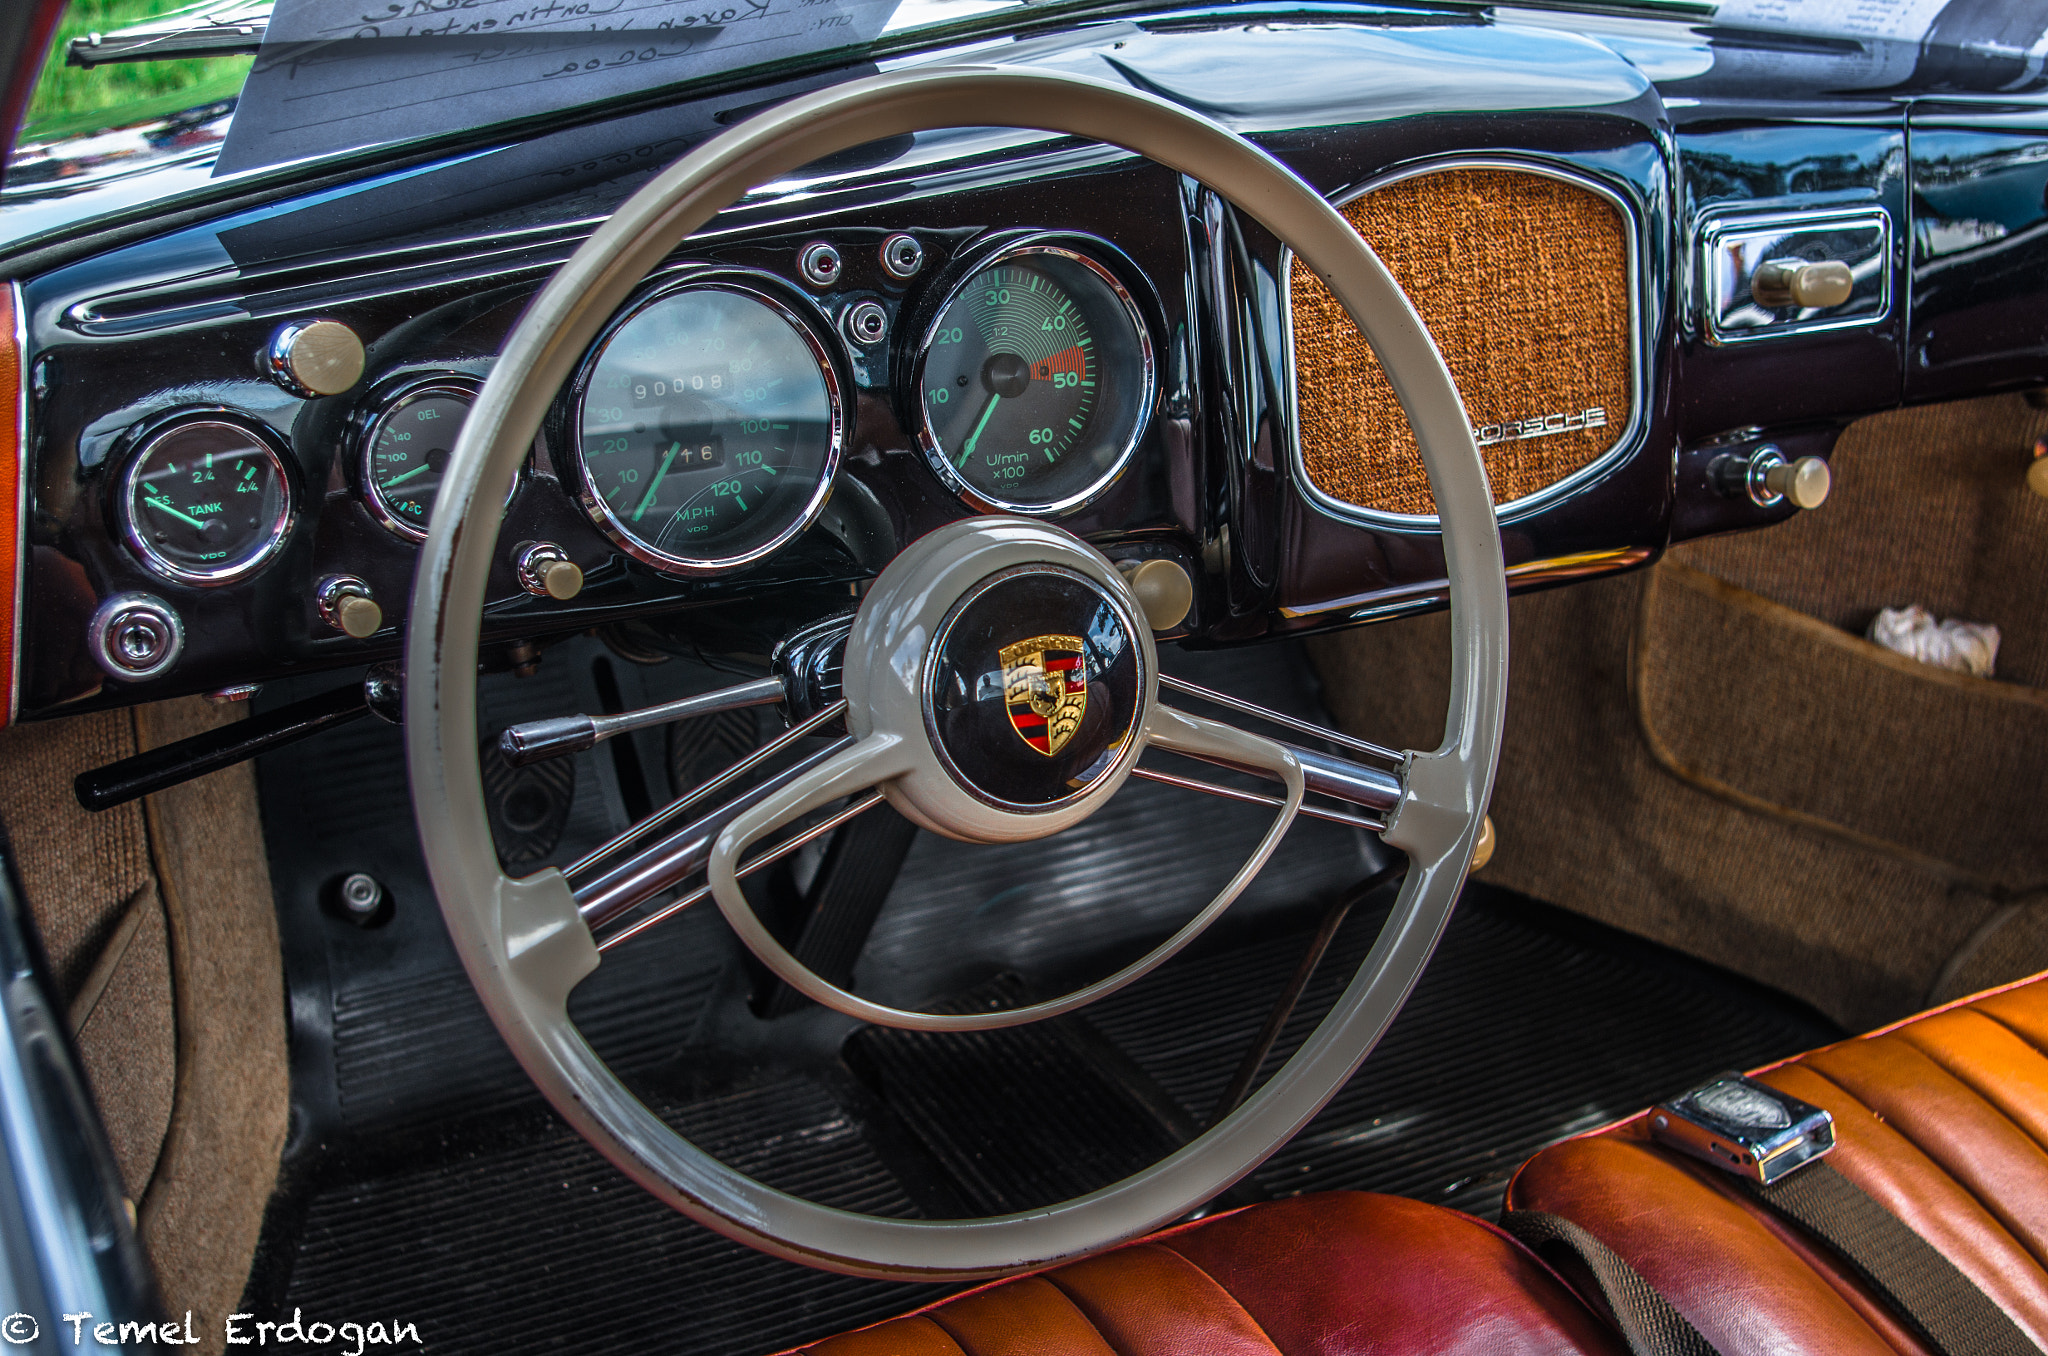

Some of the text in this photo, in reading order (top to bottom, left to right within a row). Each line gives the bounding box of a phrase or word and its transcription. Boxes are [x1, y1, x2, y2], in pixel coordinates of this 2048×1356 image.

[985, 289, 1010, 306] 30
[1041, 316, 1066, 331] 40
[937, 327, 963, 344] 20
[993, 327, 1008, 337] 1:2
[607, 375, 631, 389] 40
[635, 374, 723, 399] 90008
[1053, 372, 1079, 389] 50
[744, 387, 766, 402] 90
[928, 387, 949, 404] 10
[417, 408, 440, 421] OEL
[598, 407, 622, 423] 30
[740, 418, 770, 434] 100
[1473, 407, 1606, 441] ORSCHE
[393, 432, 411, 442] 140
[1029, 428, 1053, 444] 60
[603, 438, 628, 454] 20
[388, 452, 407, 463] 100
[735, 450, 762, 466] 110
[986, 451, 1029, 466] U/min
[192, 471, 215, 484] 2/4
[618, 469, 638, 483] 10
[237, 481, 259, 493] 4/4
[711, 480, 742, 497] 120
[145, 495, 175, 508] ES.
[188, 502, 223, 516] TANK
[687, 525, 708, 533] VDO
[200, 551, 227, 560] VDO
